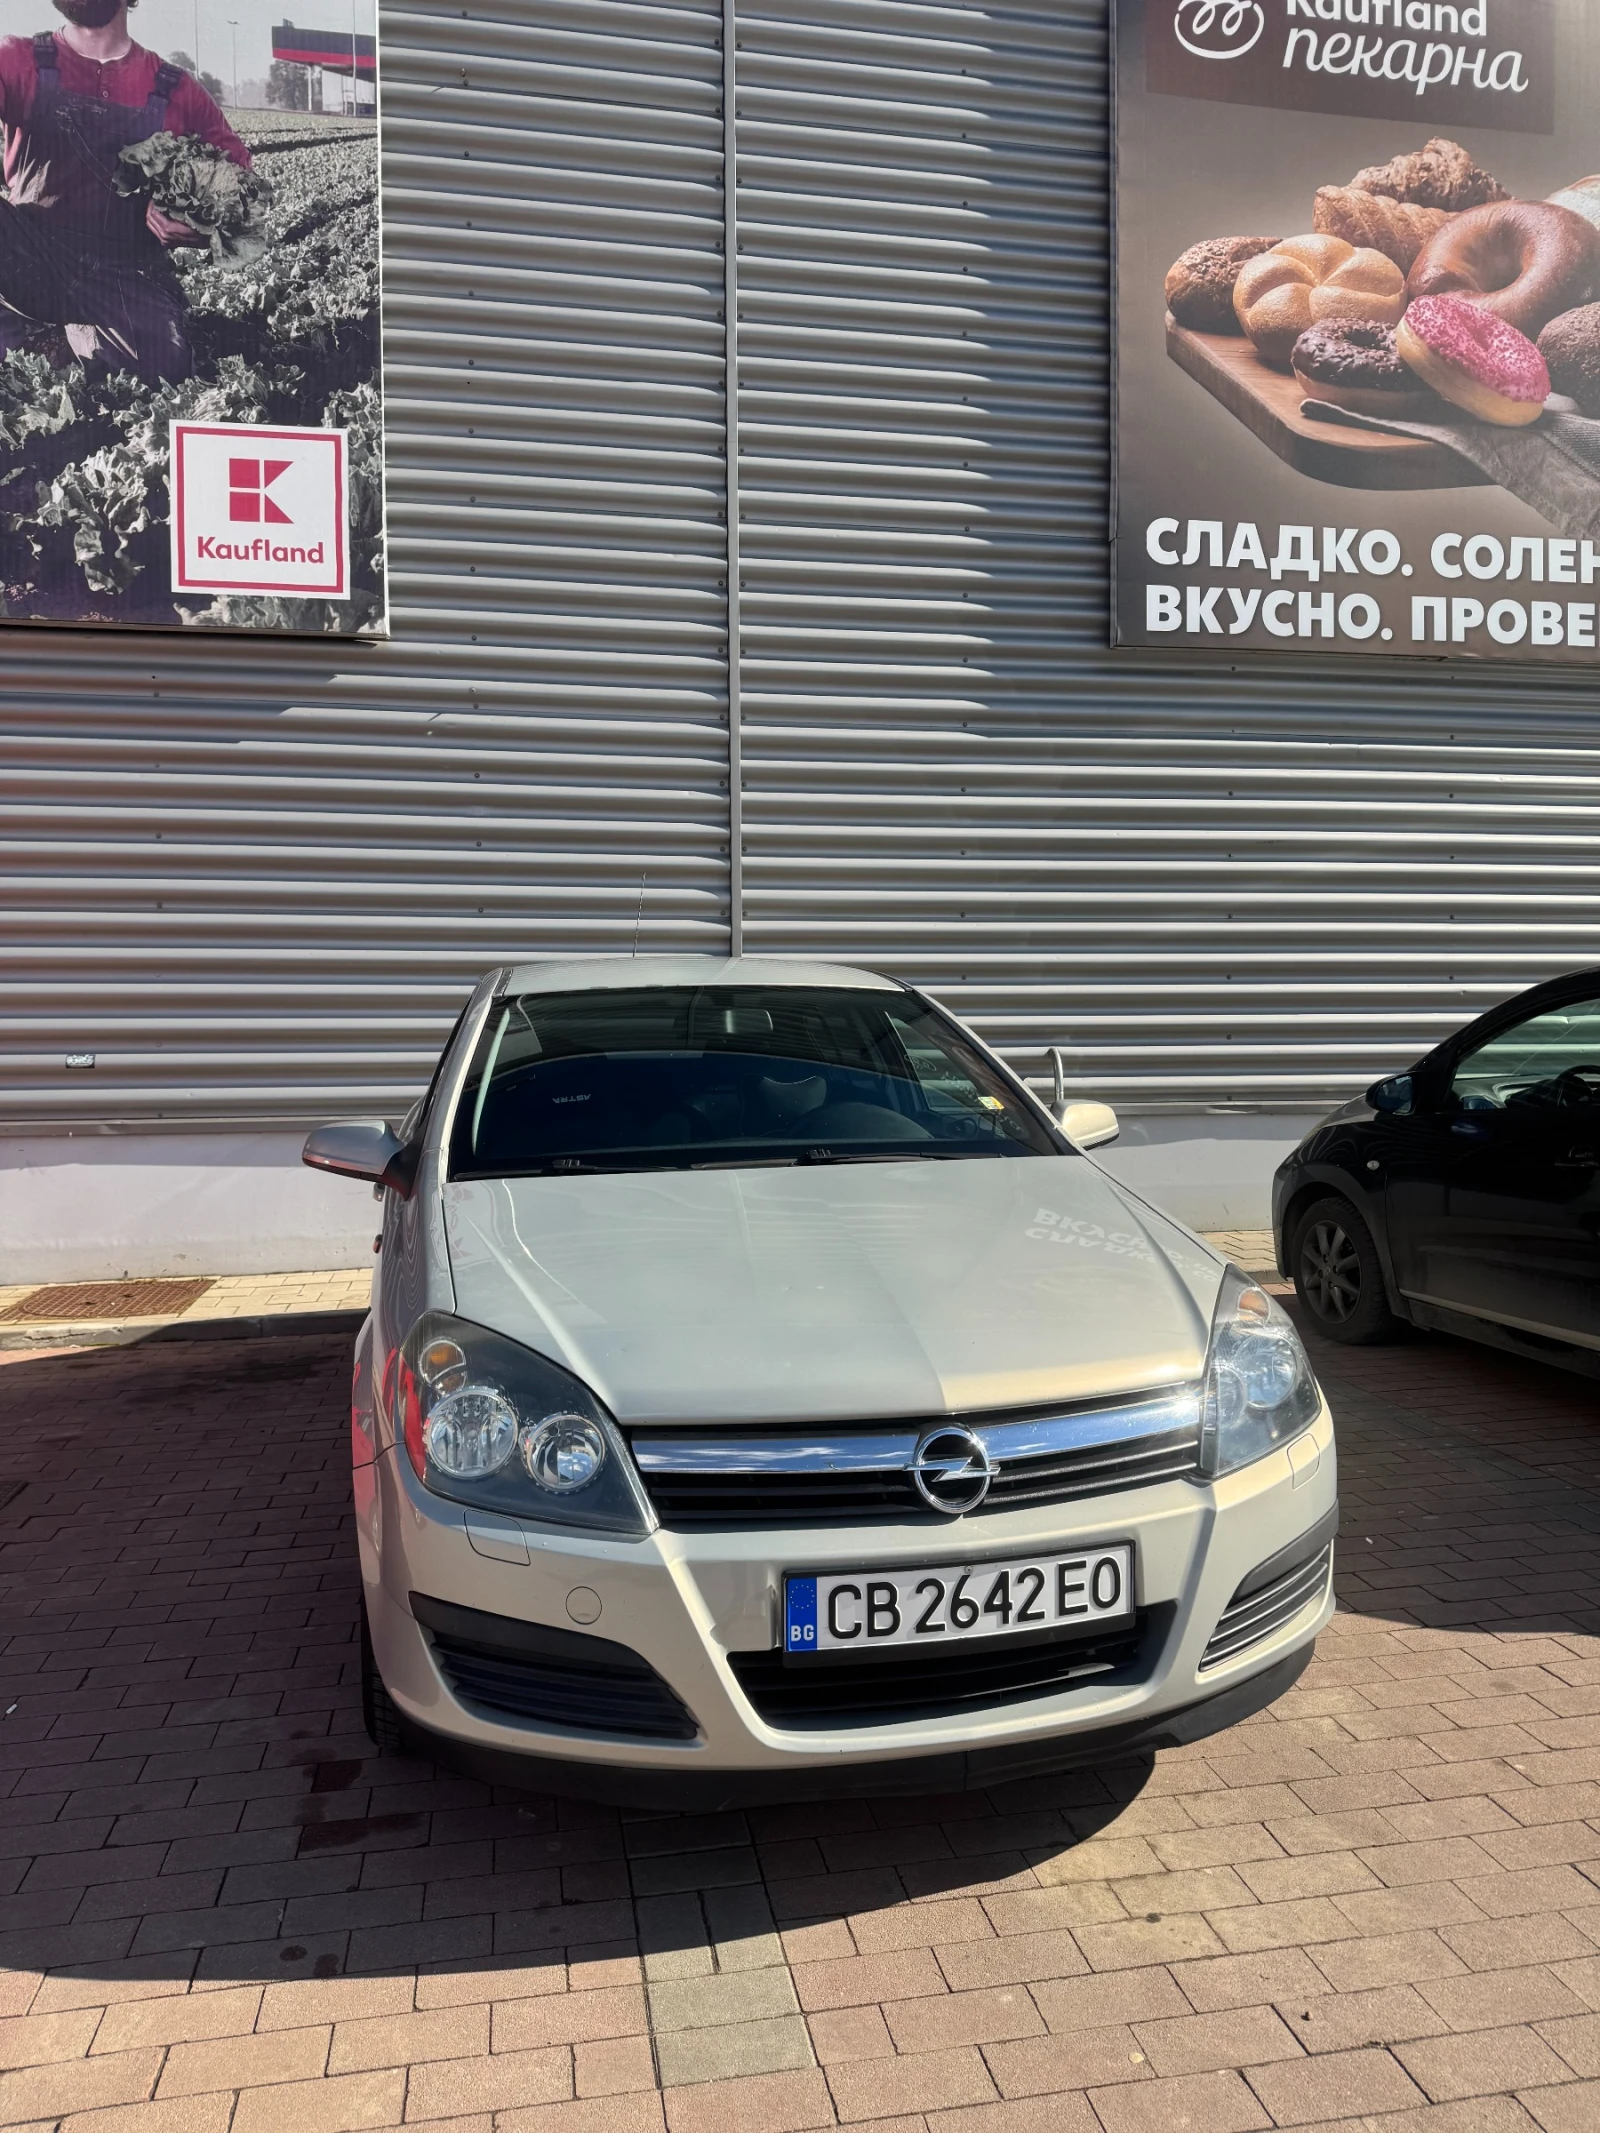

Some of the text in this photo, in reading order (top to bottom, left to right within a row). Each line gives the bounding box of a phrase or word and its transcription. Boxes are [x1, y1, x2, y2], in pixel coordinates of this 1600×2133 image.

[1282, 27, 1529, 96] пекарна
[197, 536, 324, 563] Kaufland
[1146, 517, 1414, 582] СЛАДКО.
[1146, 584, 1600, 647] ВКУСНО. ПРОВЕ
[552, 1094, 591, 1103] ASTRA
[790, 1624, 815, 1642] BG
[828, 1581, 901, 1639] CB
[915, 1567, 1046, 1634] 2642
